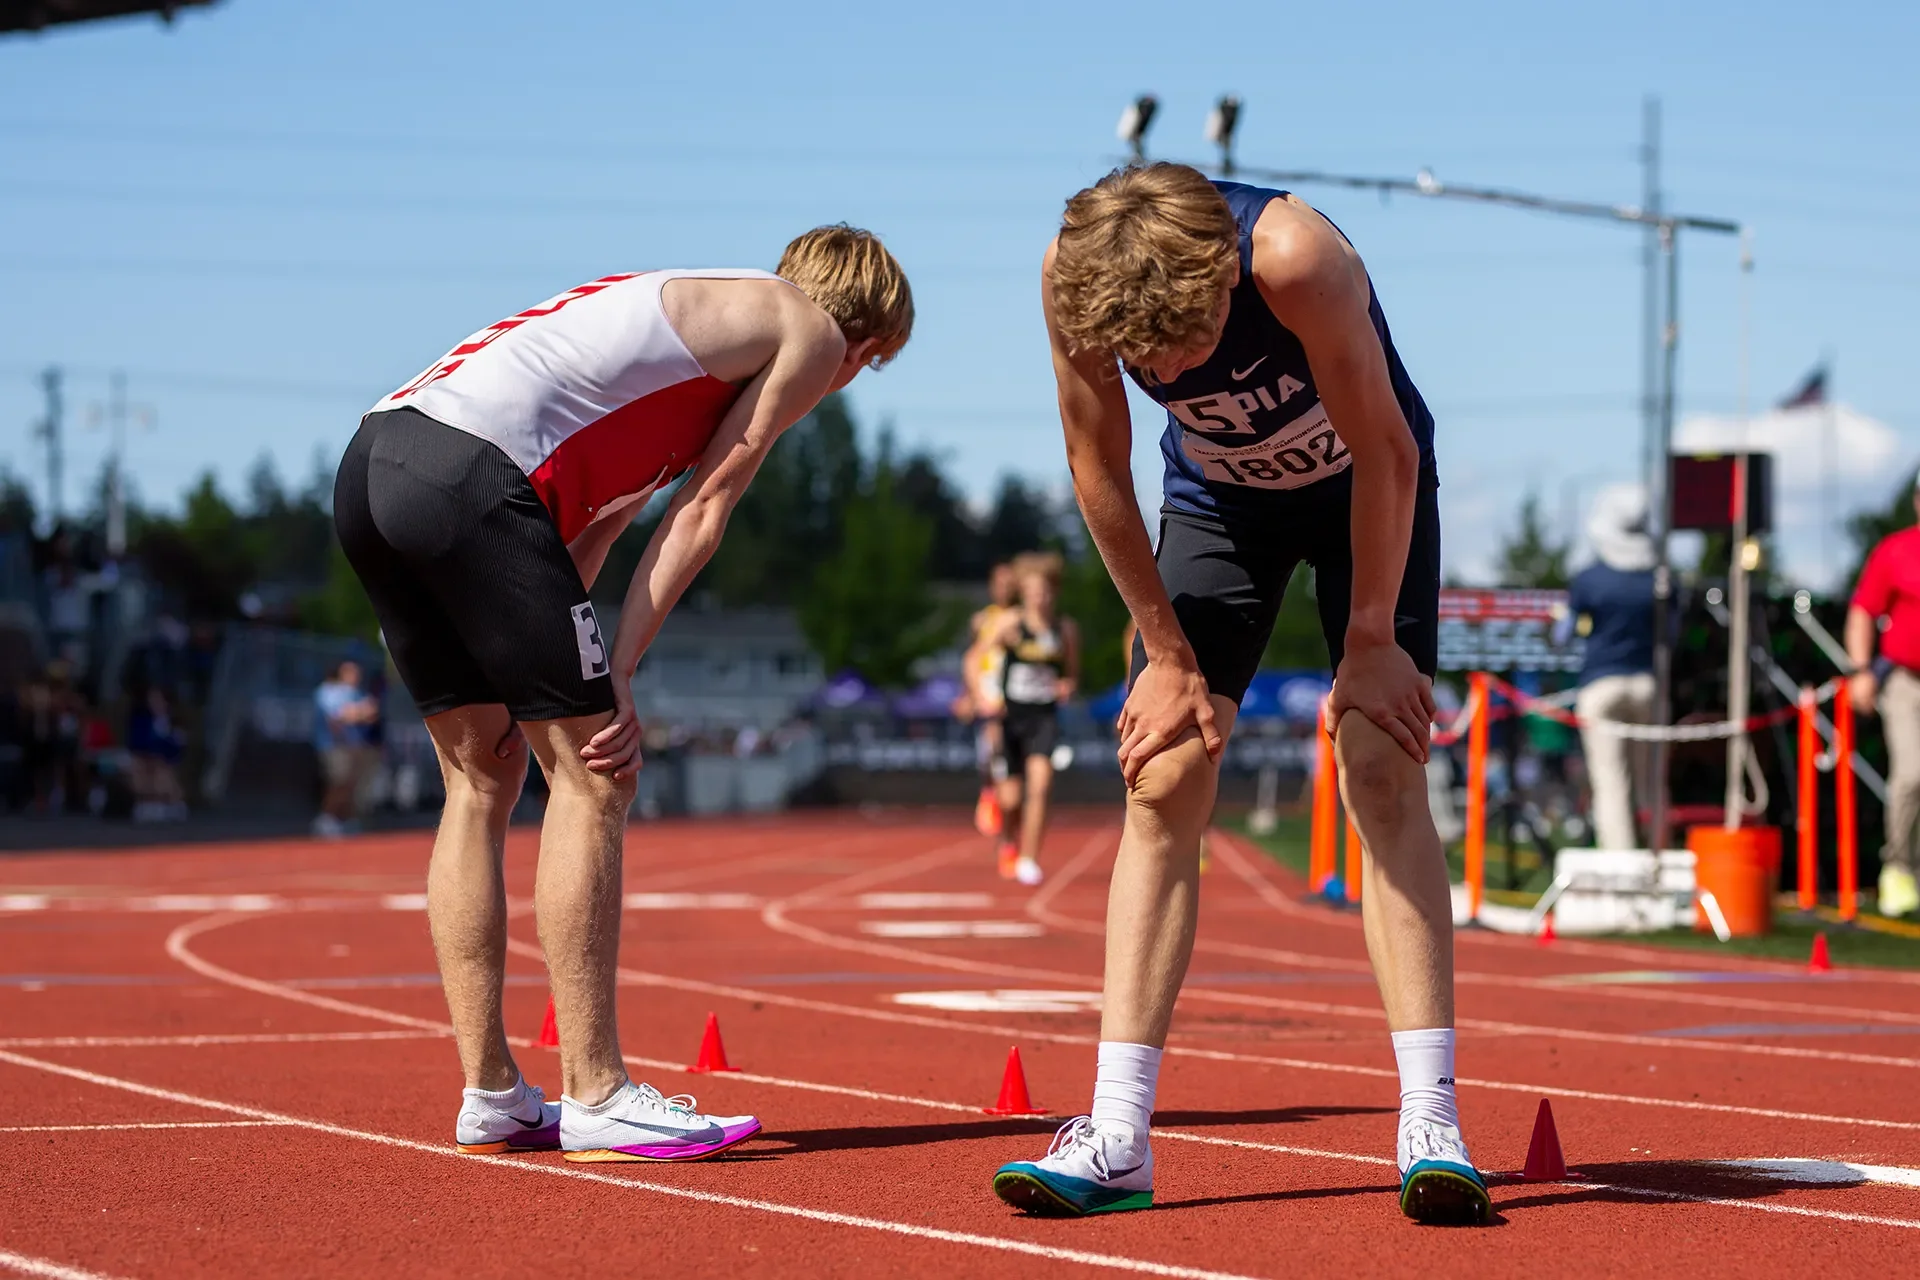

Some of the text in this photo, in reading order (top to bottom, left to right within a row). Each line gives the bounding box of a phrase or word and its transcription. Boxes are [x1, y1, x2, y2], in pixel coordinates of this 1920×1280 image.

[1185, 399, 1237, 431] 5
[1208, 429, 1350, 482] 1802
[580, 606, 607, 673] 3
